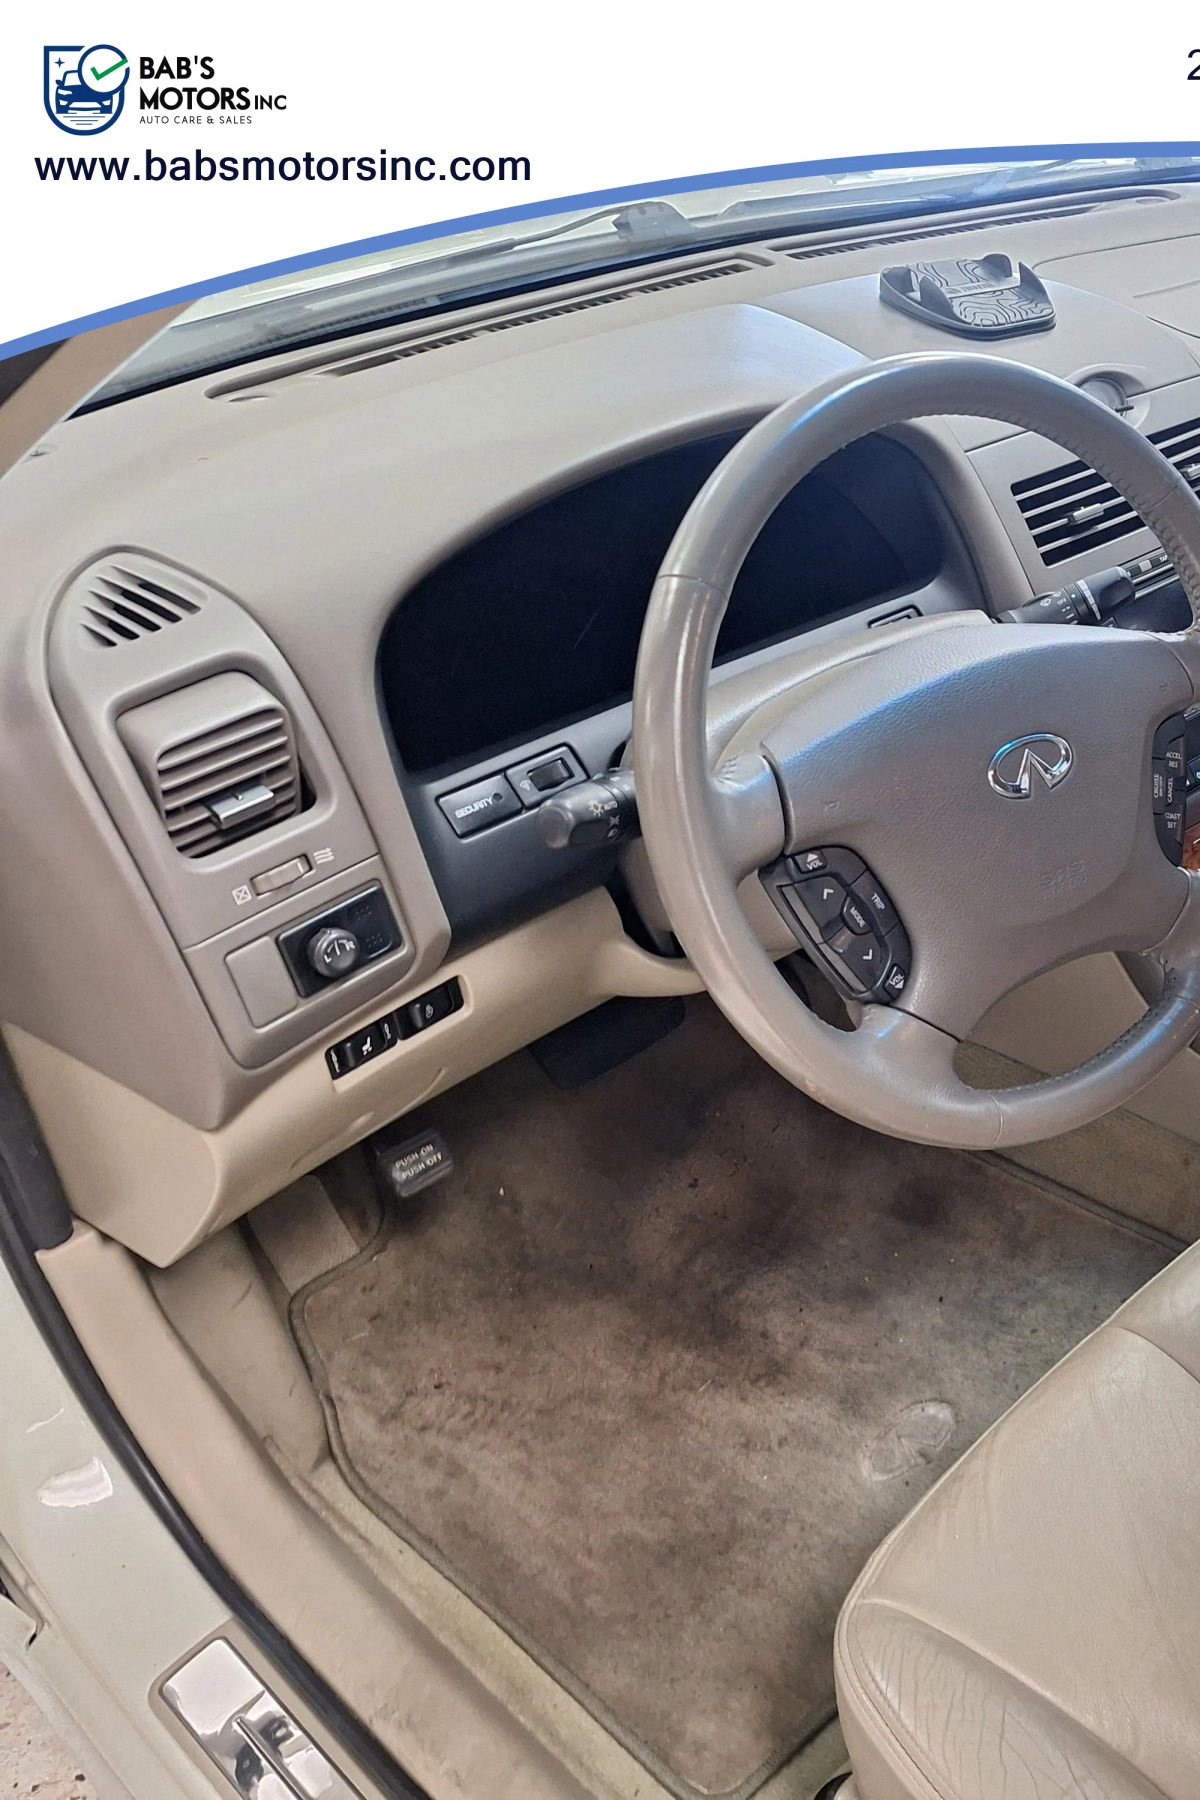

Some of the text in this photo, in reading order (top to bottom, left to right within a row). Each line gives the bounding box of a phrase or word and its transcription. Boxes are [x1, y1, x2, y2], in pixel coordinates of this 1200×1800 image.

[1166, 751, 1182, 760] ACCEL
[454, 796, 494, 819] SECURITY
[806, 860, 823, 871] VOL
[871, 892, 886, 910] TRIP
[849, 906, 867, 928] MODE
[889, 973, 905, 986] VOL
[395, 1143, 434, 1168] PUSH ON
[401, 1162, 426, 1180] PUSH
